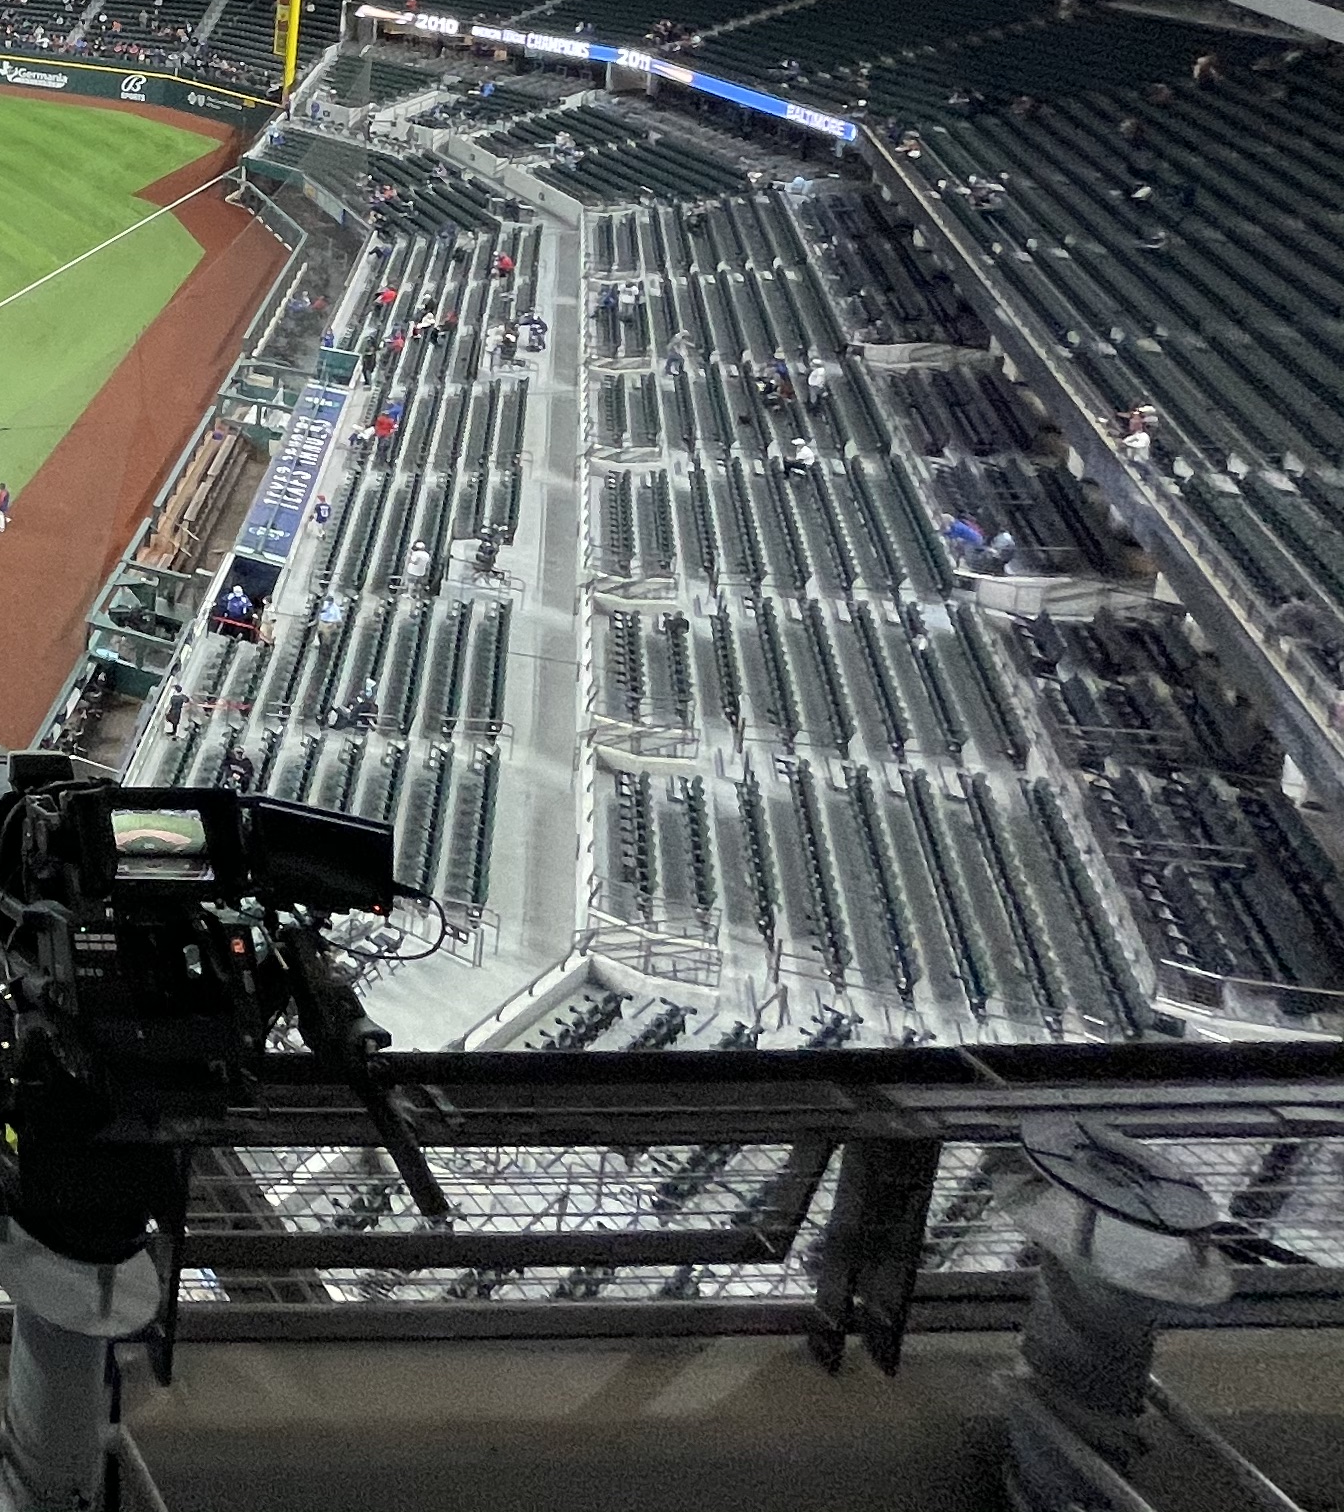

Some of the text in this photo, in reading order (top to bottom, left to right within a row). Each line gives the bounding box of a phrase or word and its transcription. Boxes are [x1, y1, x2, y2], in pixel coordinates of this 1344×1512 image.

[415, 14, 459, 35] 2010
[617, 48, 652, 72] 2011
[18, 67, 69, 84] Germania
[120, 92, 146, 102] SPORTS
[786, 103, 846, 138] BALTIMORE
